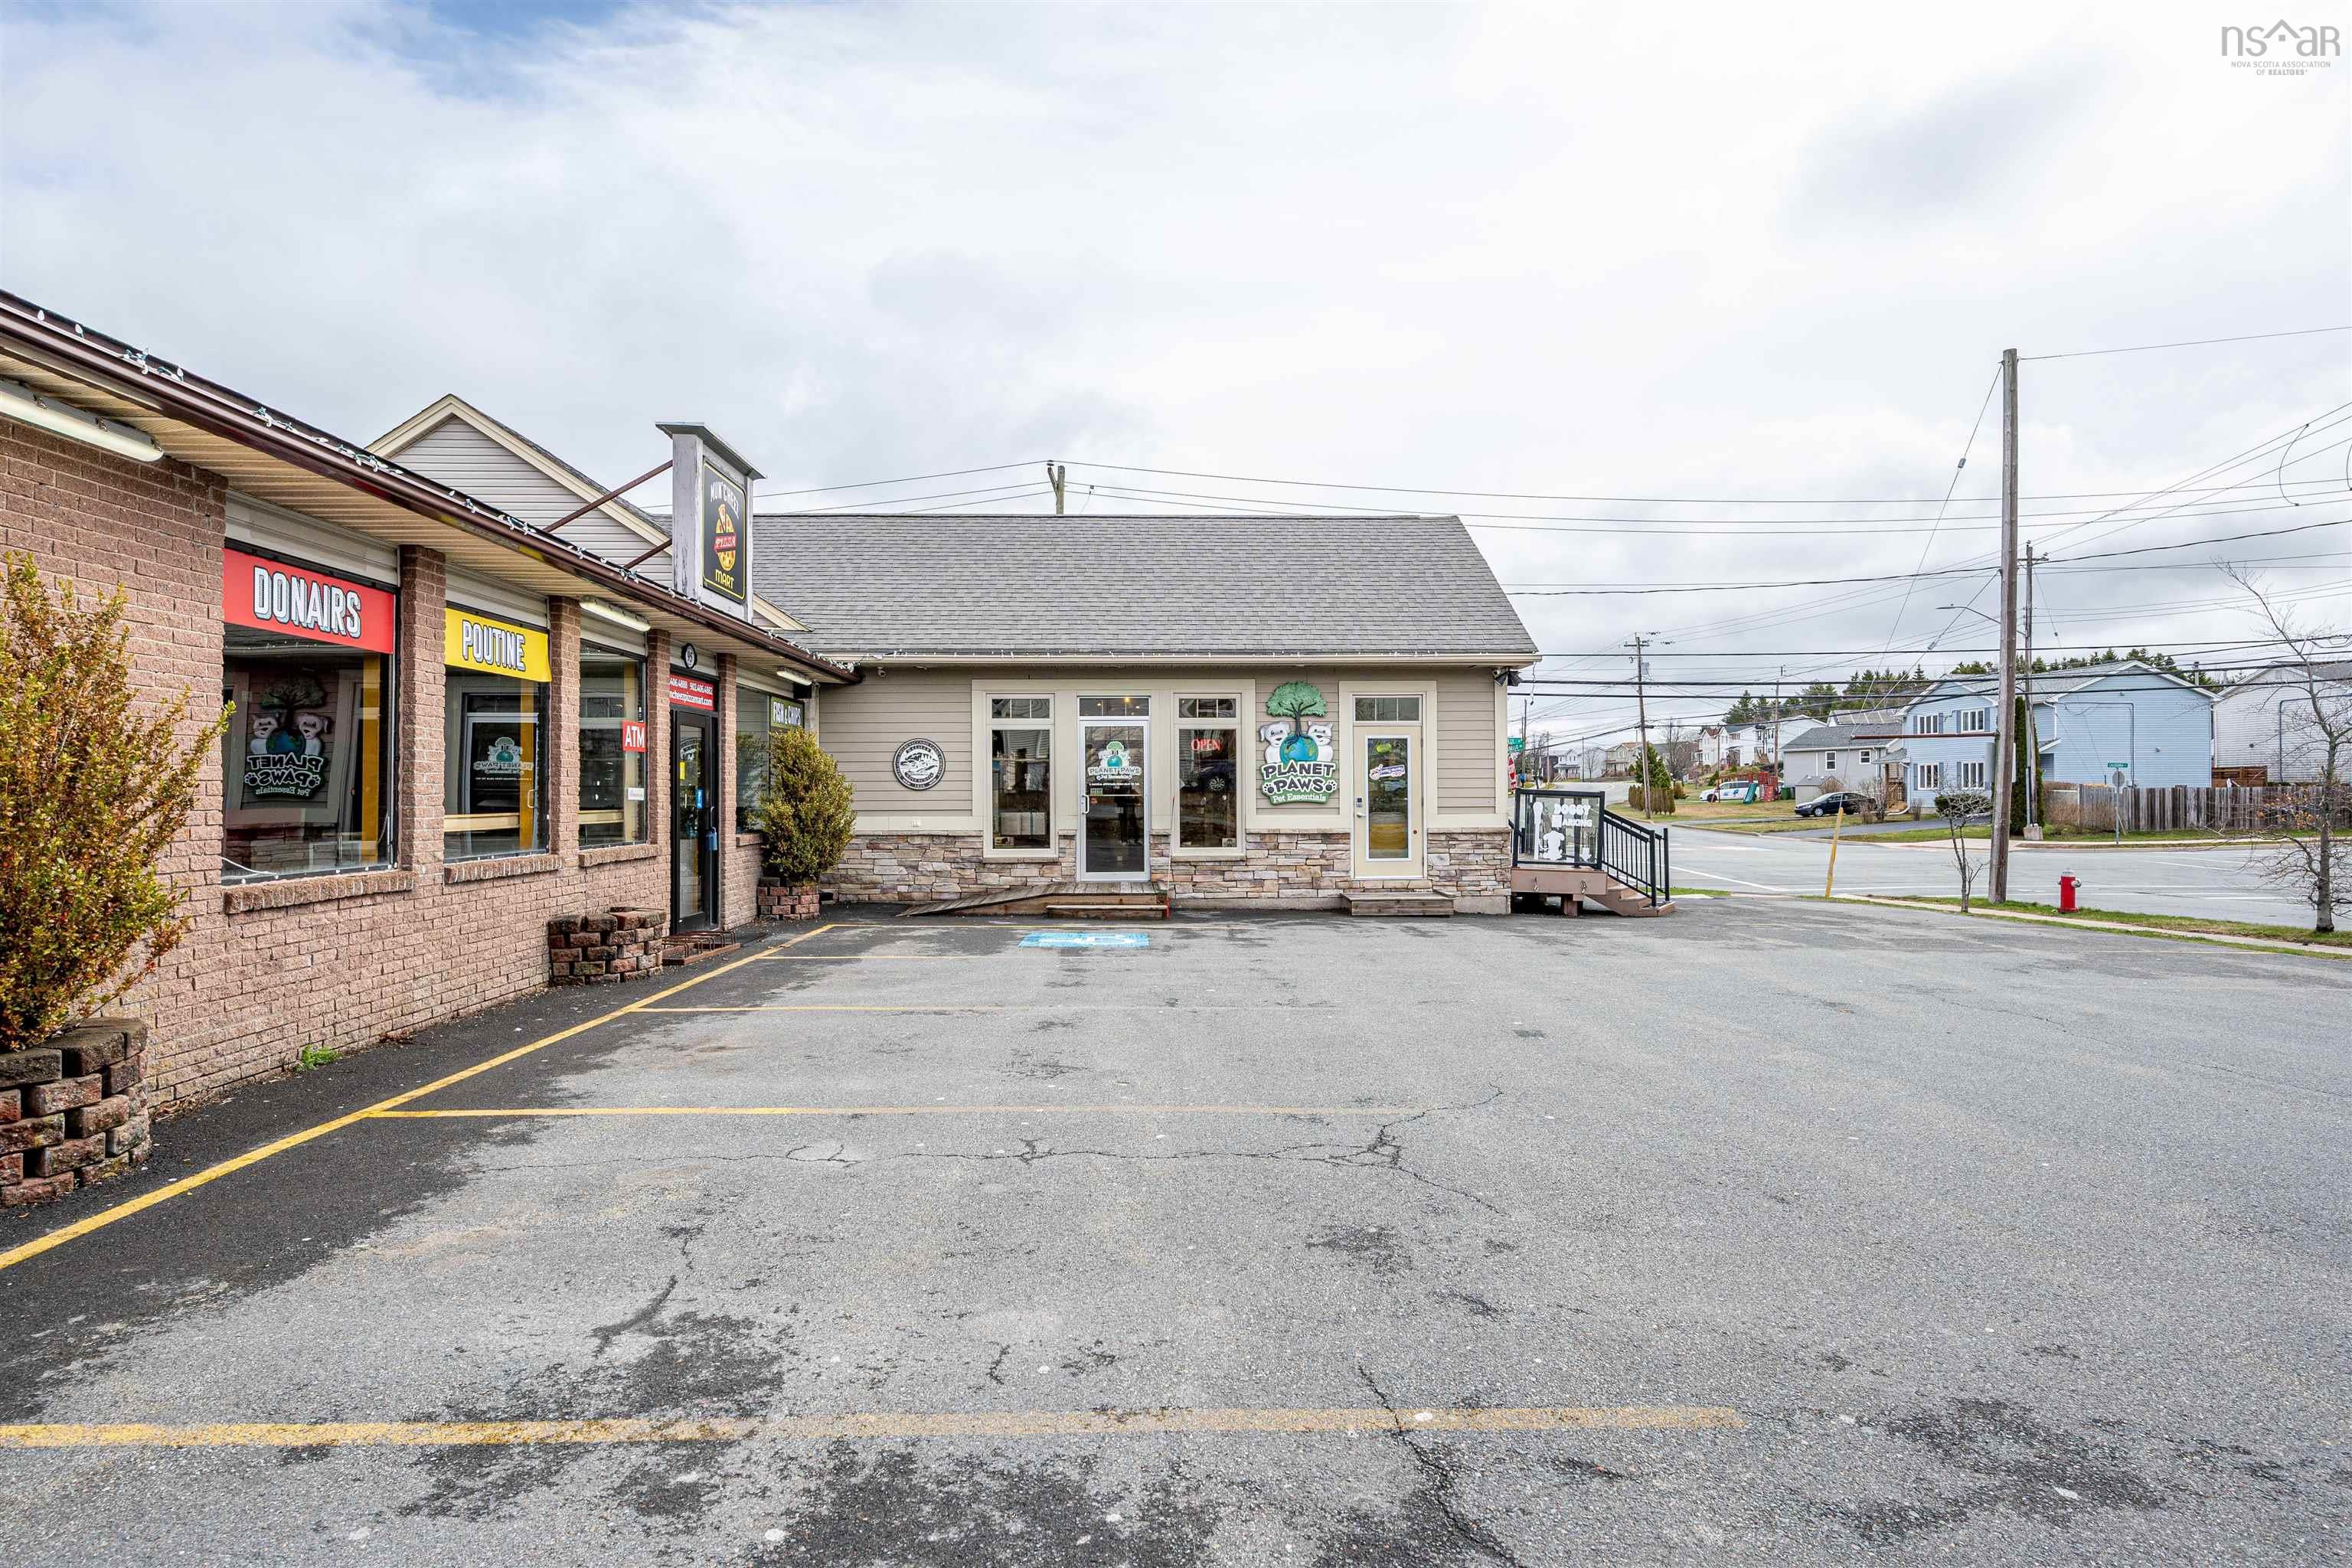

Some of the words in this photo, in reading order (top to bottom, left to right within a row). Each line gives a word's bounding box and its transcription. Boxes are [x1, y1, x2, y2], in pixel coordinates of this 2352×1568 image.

[715, 537, 736, 547] PIZZA
[253, 565, 362, 639] DONAIRS
[462, 619, 526, 672] POUTINE
[773, 701, 785, 724] FISH
[788, 705, 802, 726] CHIPS
[624, 724, 645, 748] ATM
[1191, 738, 1221, 752] OPEN
[1263, 761, 1334, 779] PLANET
[1274, 777, 1324, 793] PAWS
[1272, 795, 1286, 804] Pet
[1286, 793, 1326, 802] Essentials
[1554, 803, 1591, 815] DOGGY
